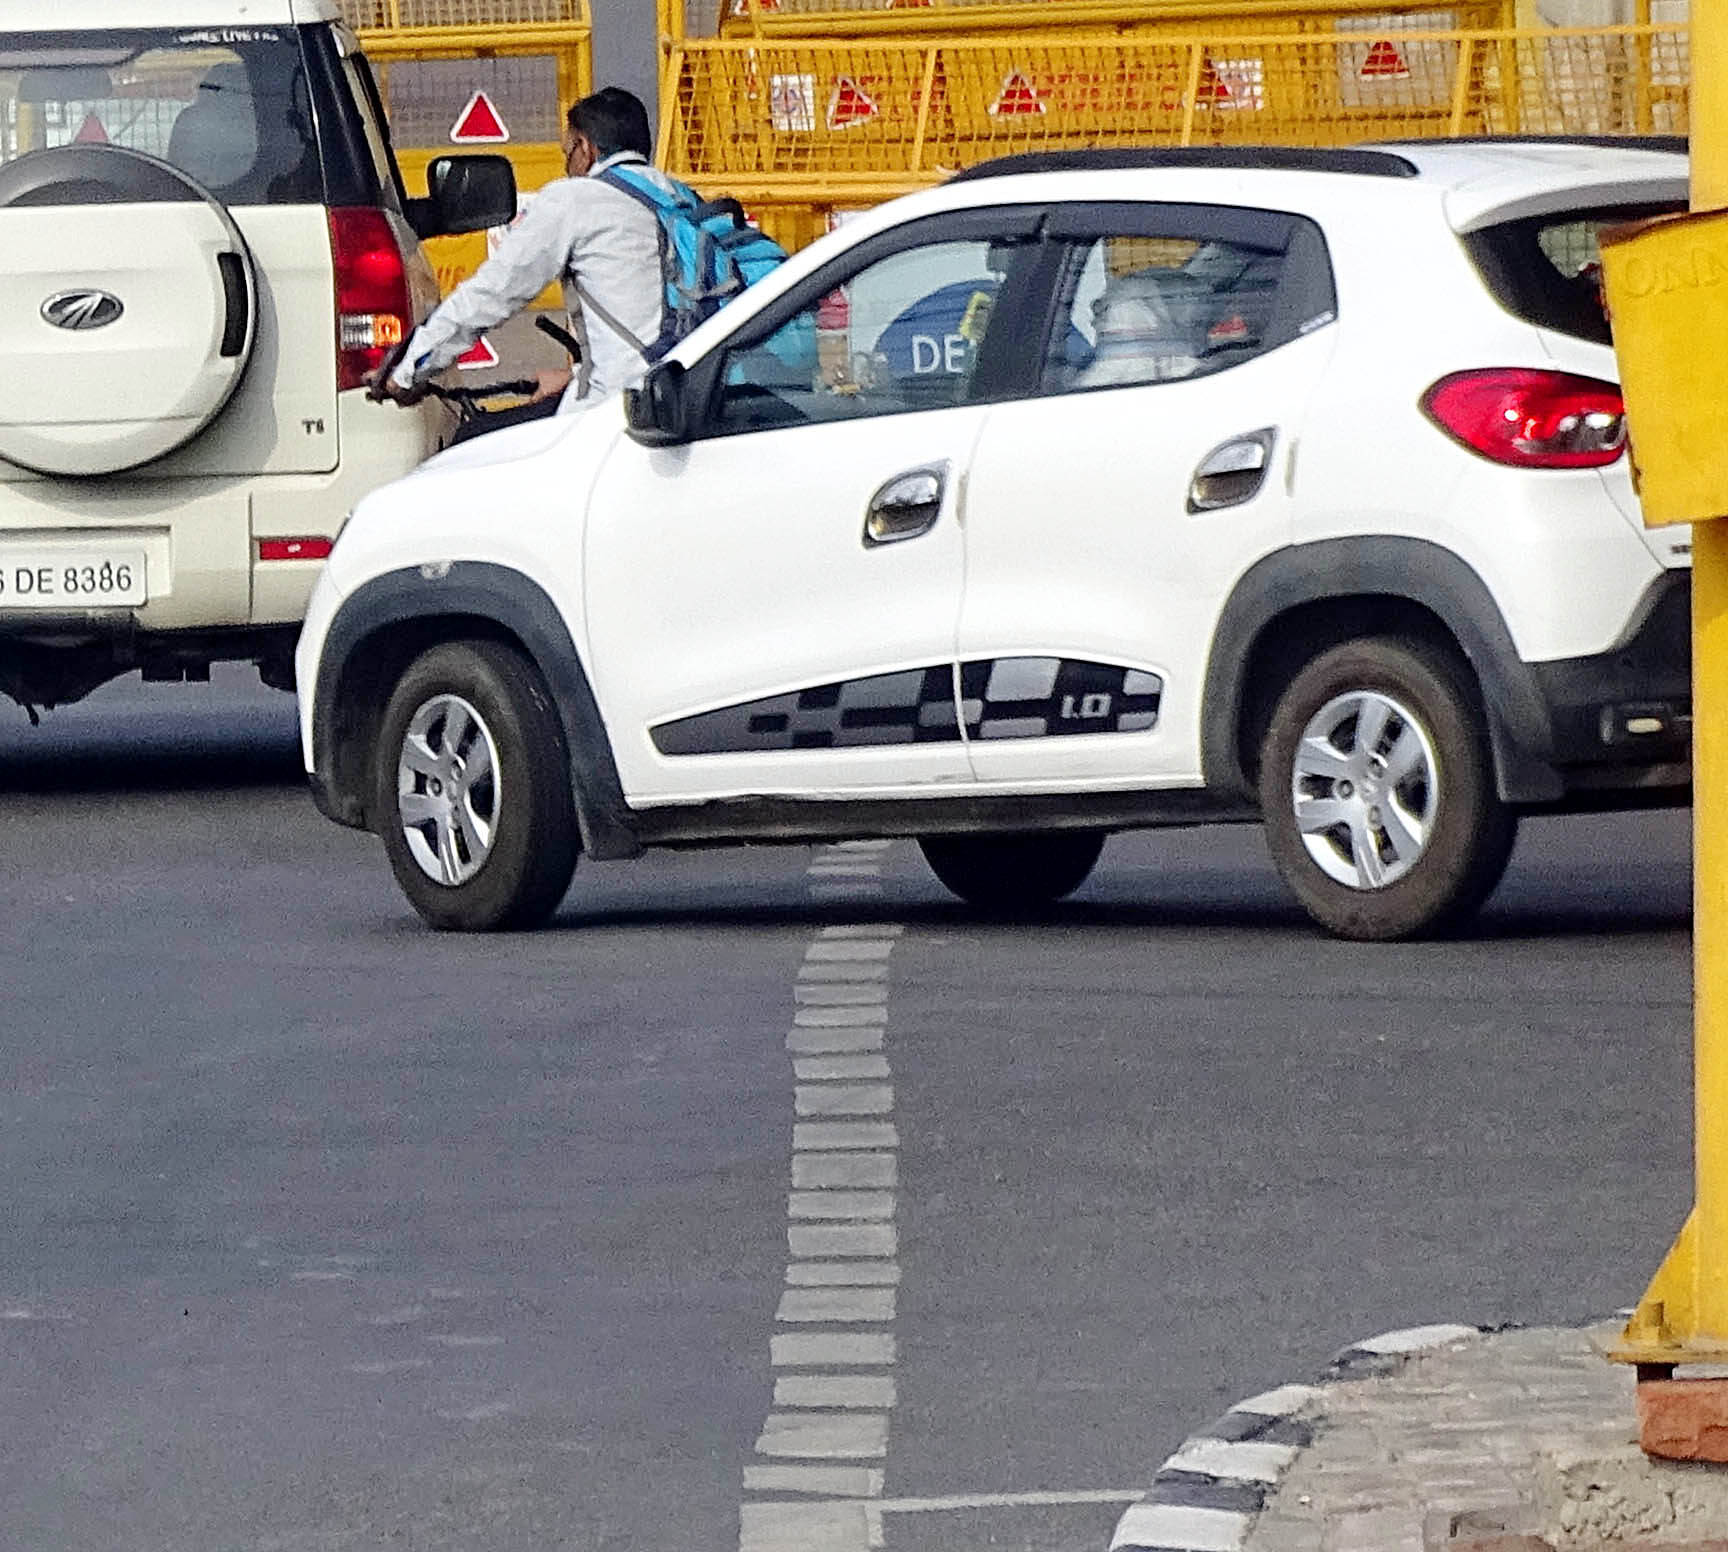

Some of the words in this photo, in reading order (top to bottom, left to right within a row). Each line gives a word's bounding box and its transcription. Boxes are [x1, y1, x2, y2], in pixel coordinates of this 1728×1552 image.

[15, 567, 54, 594] DE
[63, 565, 132, 593] 8386
[1062, 692, 1113, 720] 1.0
